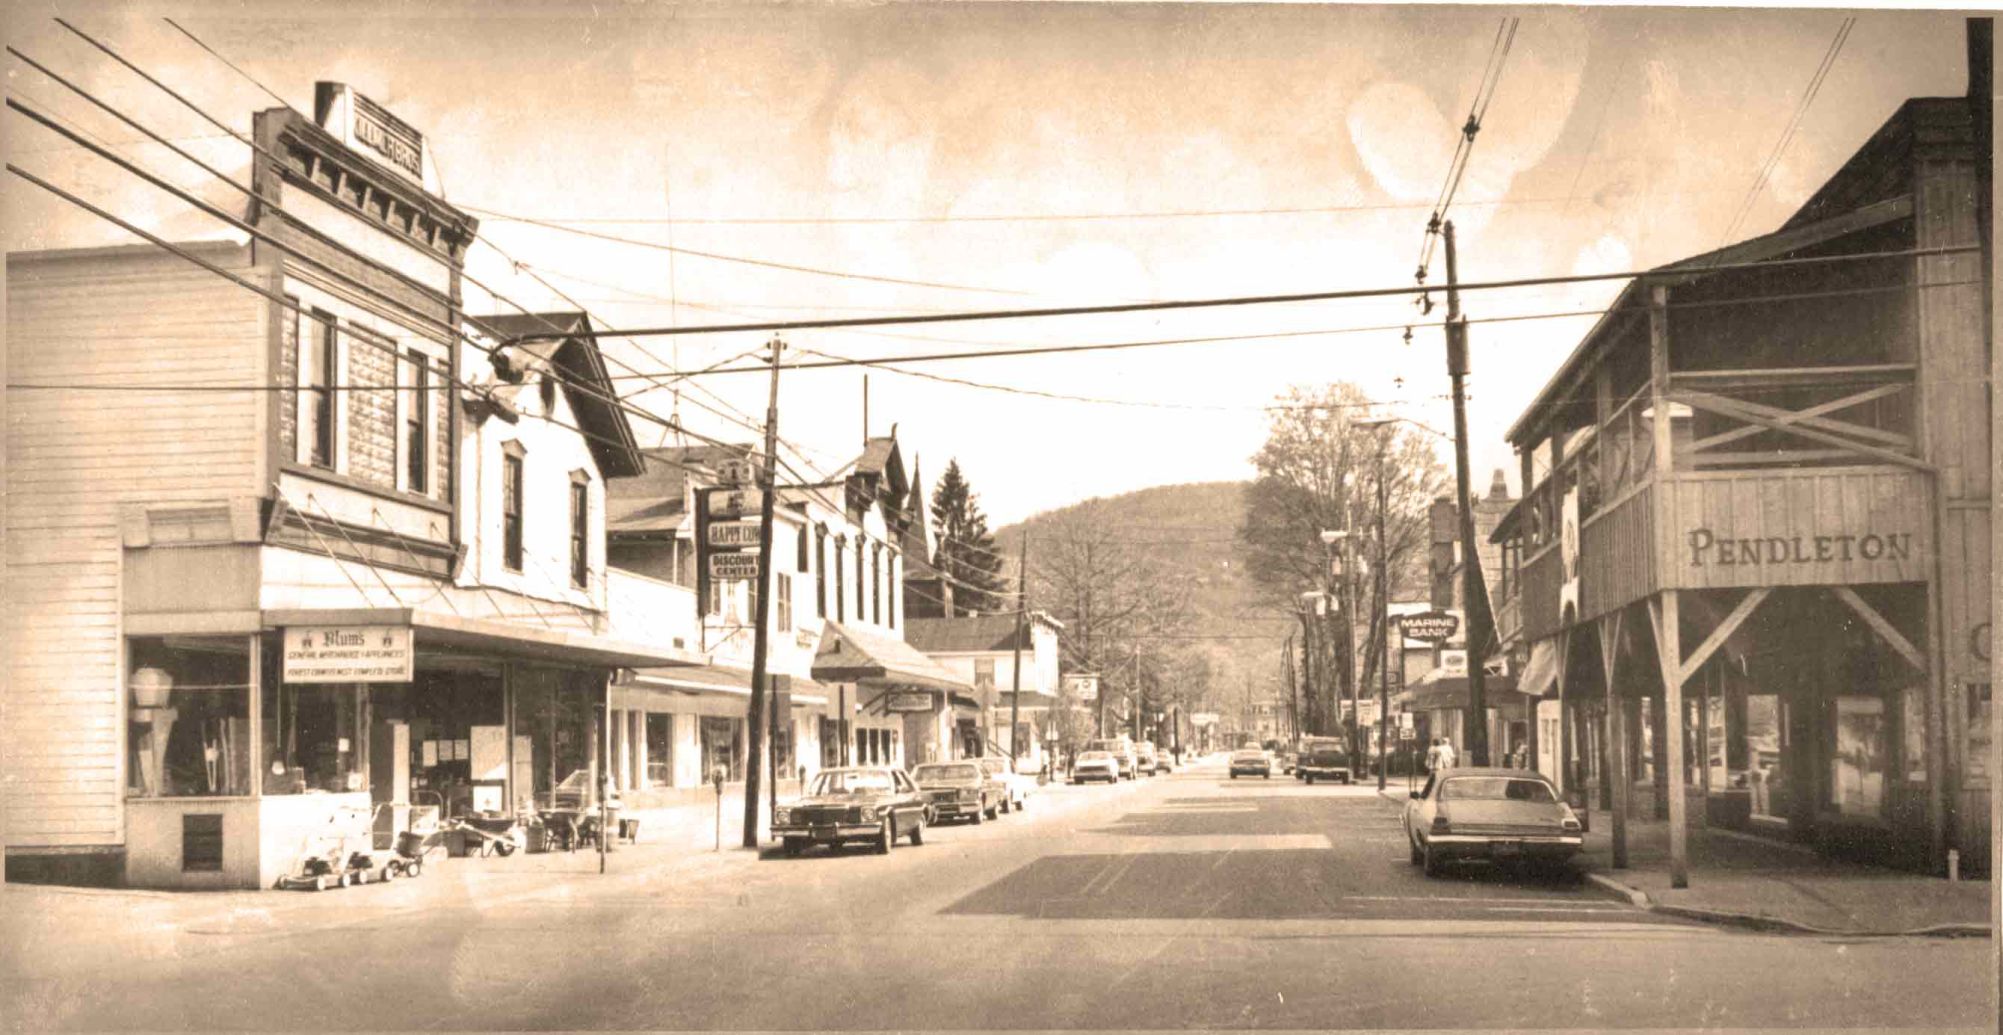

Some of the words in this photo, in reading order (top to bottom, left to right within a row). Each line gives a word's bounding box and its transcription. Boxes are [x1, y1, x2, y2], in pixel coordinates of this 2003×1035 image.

[711, 526, 740, 543] HAPPY
[1688, 528, 1912, 567] PENDLETON
[716, 566, 757, 576] CENTER
[1400, 618, 1455, 628] MARINE
[1408, 628, 1448, 638] BANK
